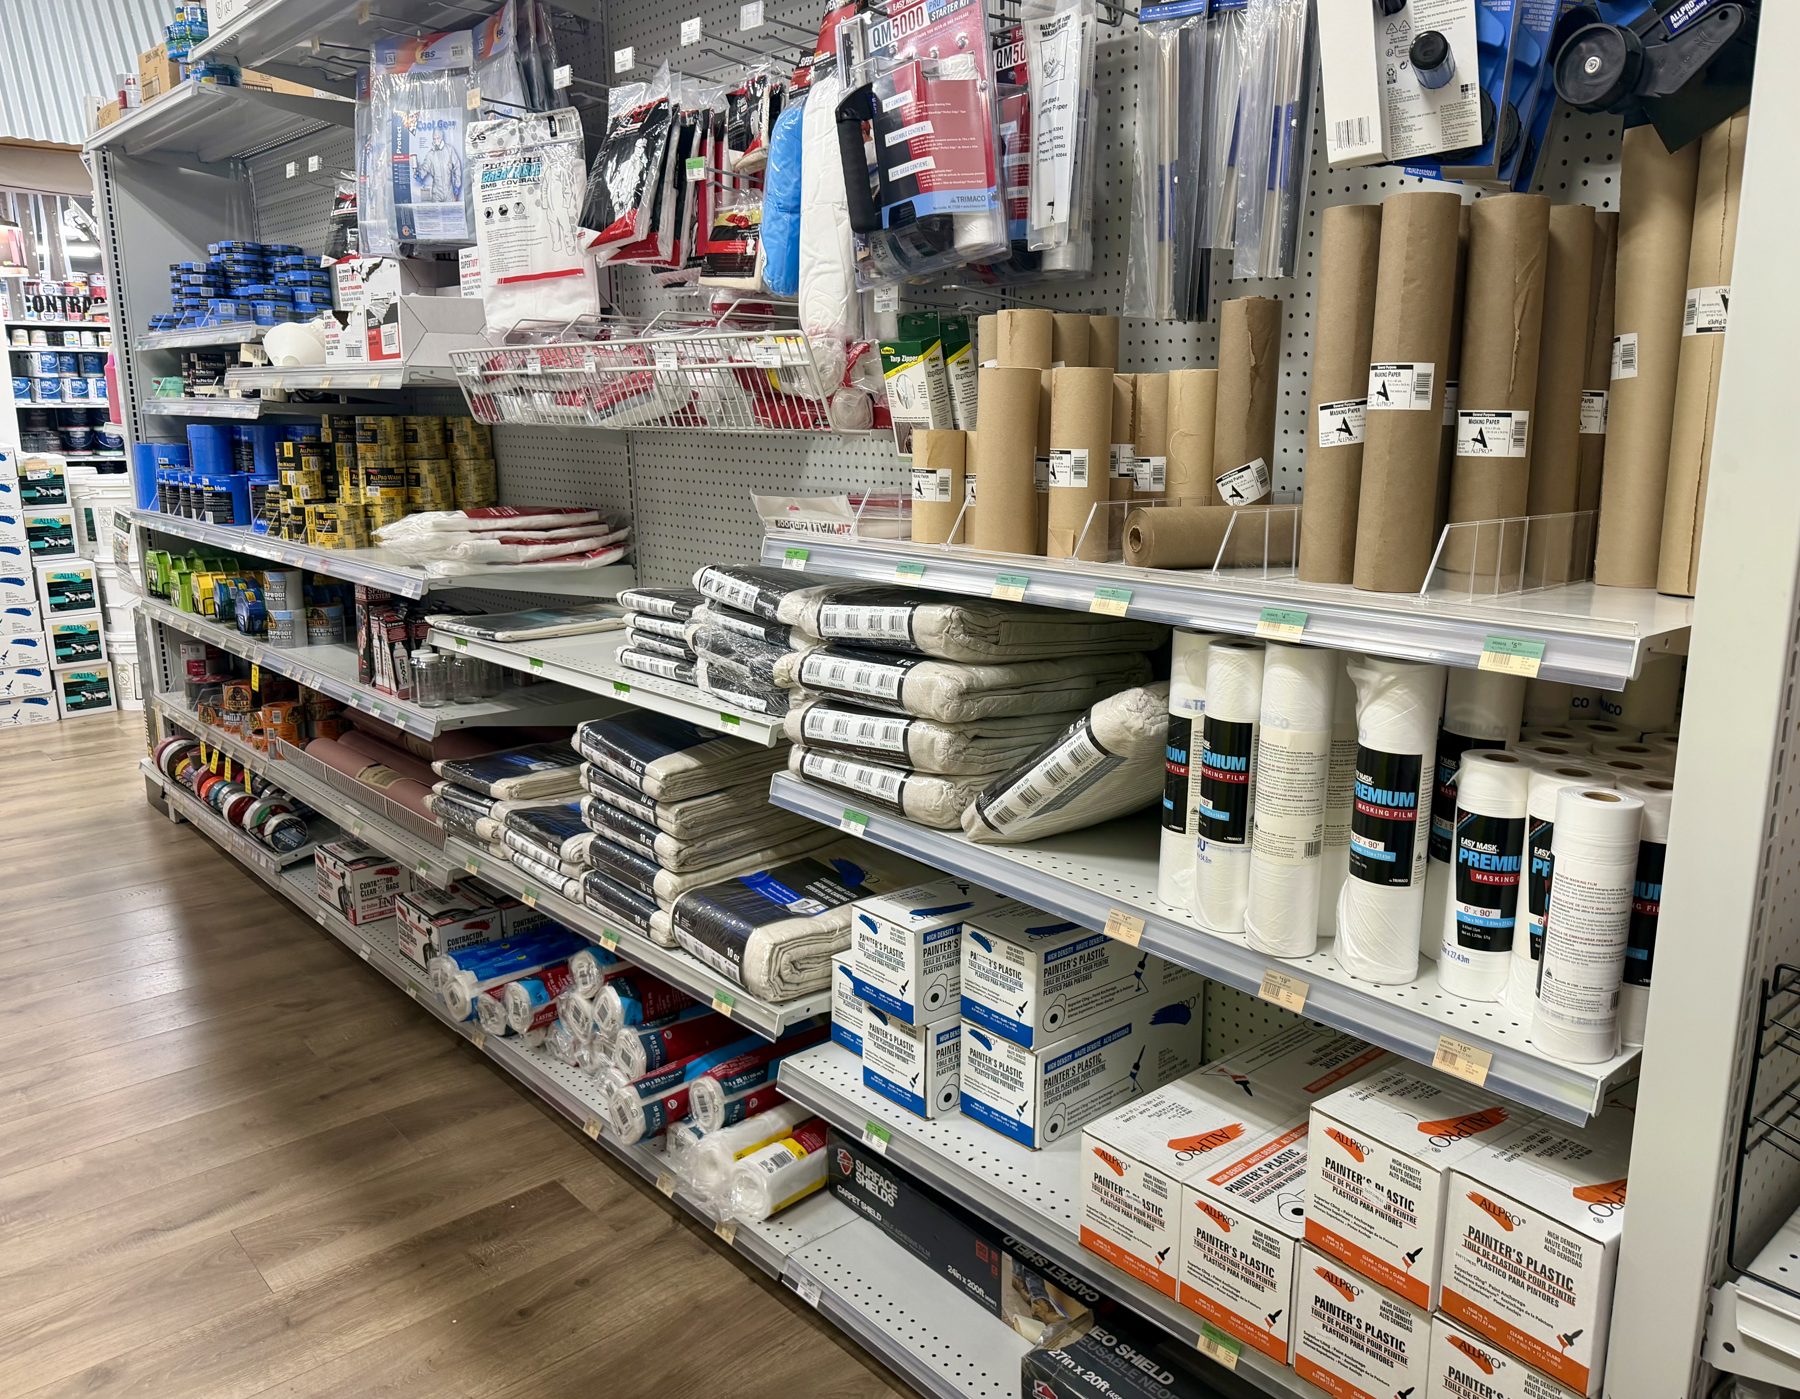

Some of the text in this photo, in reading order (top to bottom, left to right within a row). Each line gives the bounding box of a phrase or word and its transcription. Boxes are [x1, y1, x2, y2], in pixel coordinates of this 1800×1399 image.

[931, 4, 958, 20] STARTER
[1670, 1, 1694, 24] ALLPRO
[1673, 1, 1708, 28] Quality Masking
[872, 6, 924, 48] QM5000
[996, 42, 1026, 68] QM50
[416, 120, 435, 130] Cool
[481, 182, 497, 190] SMS
[956, 194, 986, 204] TRIMACO
[890, 354, 919, 363] Tarp Zipper
[1202, 750, 1246, 771] EMIUM
[1226, 774, 1245, 782] FILM
[1358, 803, 1413, 818] MASKING FILM
[1461, 837, 1498, 852] EASY MASK
[1459, 848, 1521, 872] PREMIU
[1476, 873, 1514, 884] MASKING
[1478, 908, 1492, 918] 90'
[447, 930, 484, 946] CONTRACTOR
[923, 938, 959, 958] PAINTER'S
[727, 947, 740, 963] 10 oz
[1044, 947, 1105, 979] PAINTER'S PLASTIC
[998, 960, 1022, 980] PLASTIC
[869, 1022, 914, 1053] PAINTER'S PLASTIC
[969, 1048, 1023, 1080] PAINTER'S PLASTIC
[1043, 1052, 1103, 1090] PAINTER'S PLASTIC
[1174, 1129, 1231, 1162] ALLPRO
[1334, 1131, 1370, 1156] ALLPRO
[1100, 1150, 1128, 1171] ALLPRO
[1225, 1148, 1301, 1194] PAINTER'S PLASTIC
[855, 1159, 898, 1198] SURFACE
[856, 1171, 895, 1208] SHIELDS
[837, 1185, 882, 1222] CARPET SHIELD
[1203, 1204, 1236, 1227] ALLPRO
[1480, 1198, 1522, 1226] ALLPRO
[1196, 1227, 1275, 1279] PAINTER'S PLASTIC
[1544, 1237, 1582, 1262] HAUTE DENSITÉ
[1547, 1230, 1582, 1252] HIGH DENSITY
[1003, 1236, 1100, 1302] CARPET SHIELD
[1468, 1224, 1575, 1292] PAINTER'S PLASTIC
[1544, 1244, 1582, 1269] ALTO DENSIDAD
[947, 1264, 962, 1281] 24in
[966, 1280, 986, 1298] 200ft
[1323, 1270, 1360, 1296] ALLPRO
[1464, 1238, 1576, 1306] TOILE DE PLASTIQUE POUR PEINTRE
[1476, 1256, 1560, 1308] PLASTICO PARA PINTORES
[1314, 1294, 1406, 1354] PAINTER'S PLASTIC
[1080, 1336, 1140, 1380] EUSABLE
[1115, 1344, 1174, 1386] SHIELD
[1458, 1340, 1502, 1370] ALLPRO
[1048, 1350, 1076, 1370] 27in
[1082, 1371, 1110, 1392] 20ft
